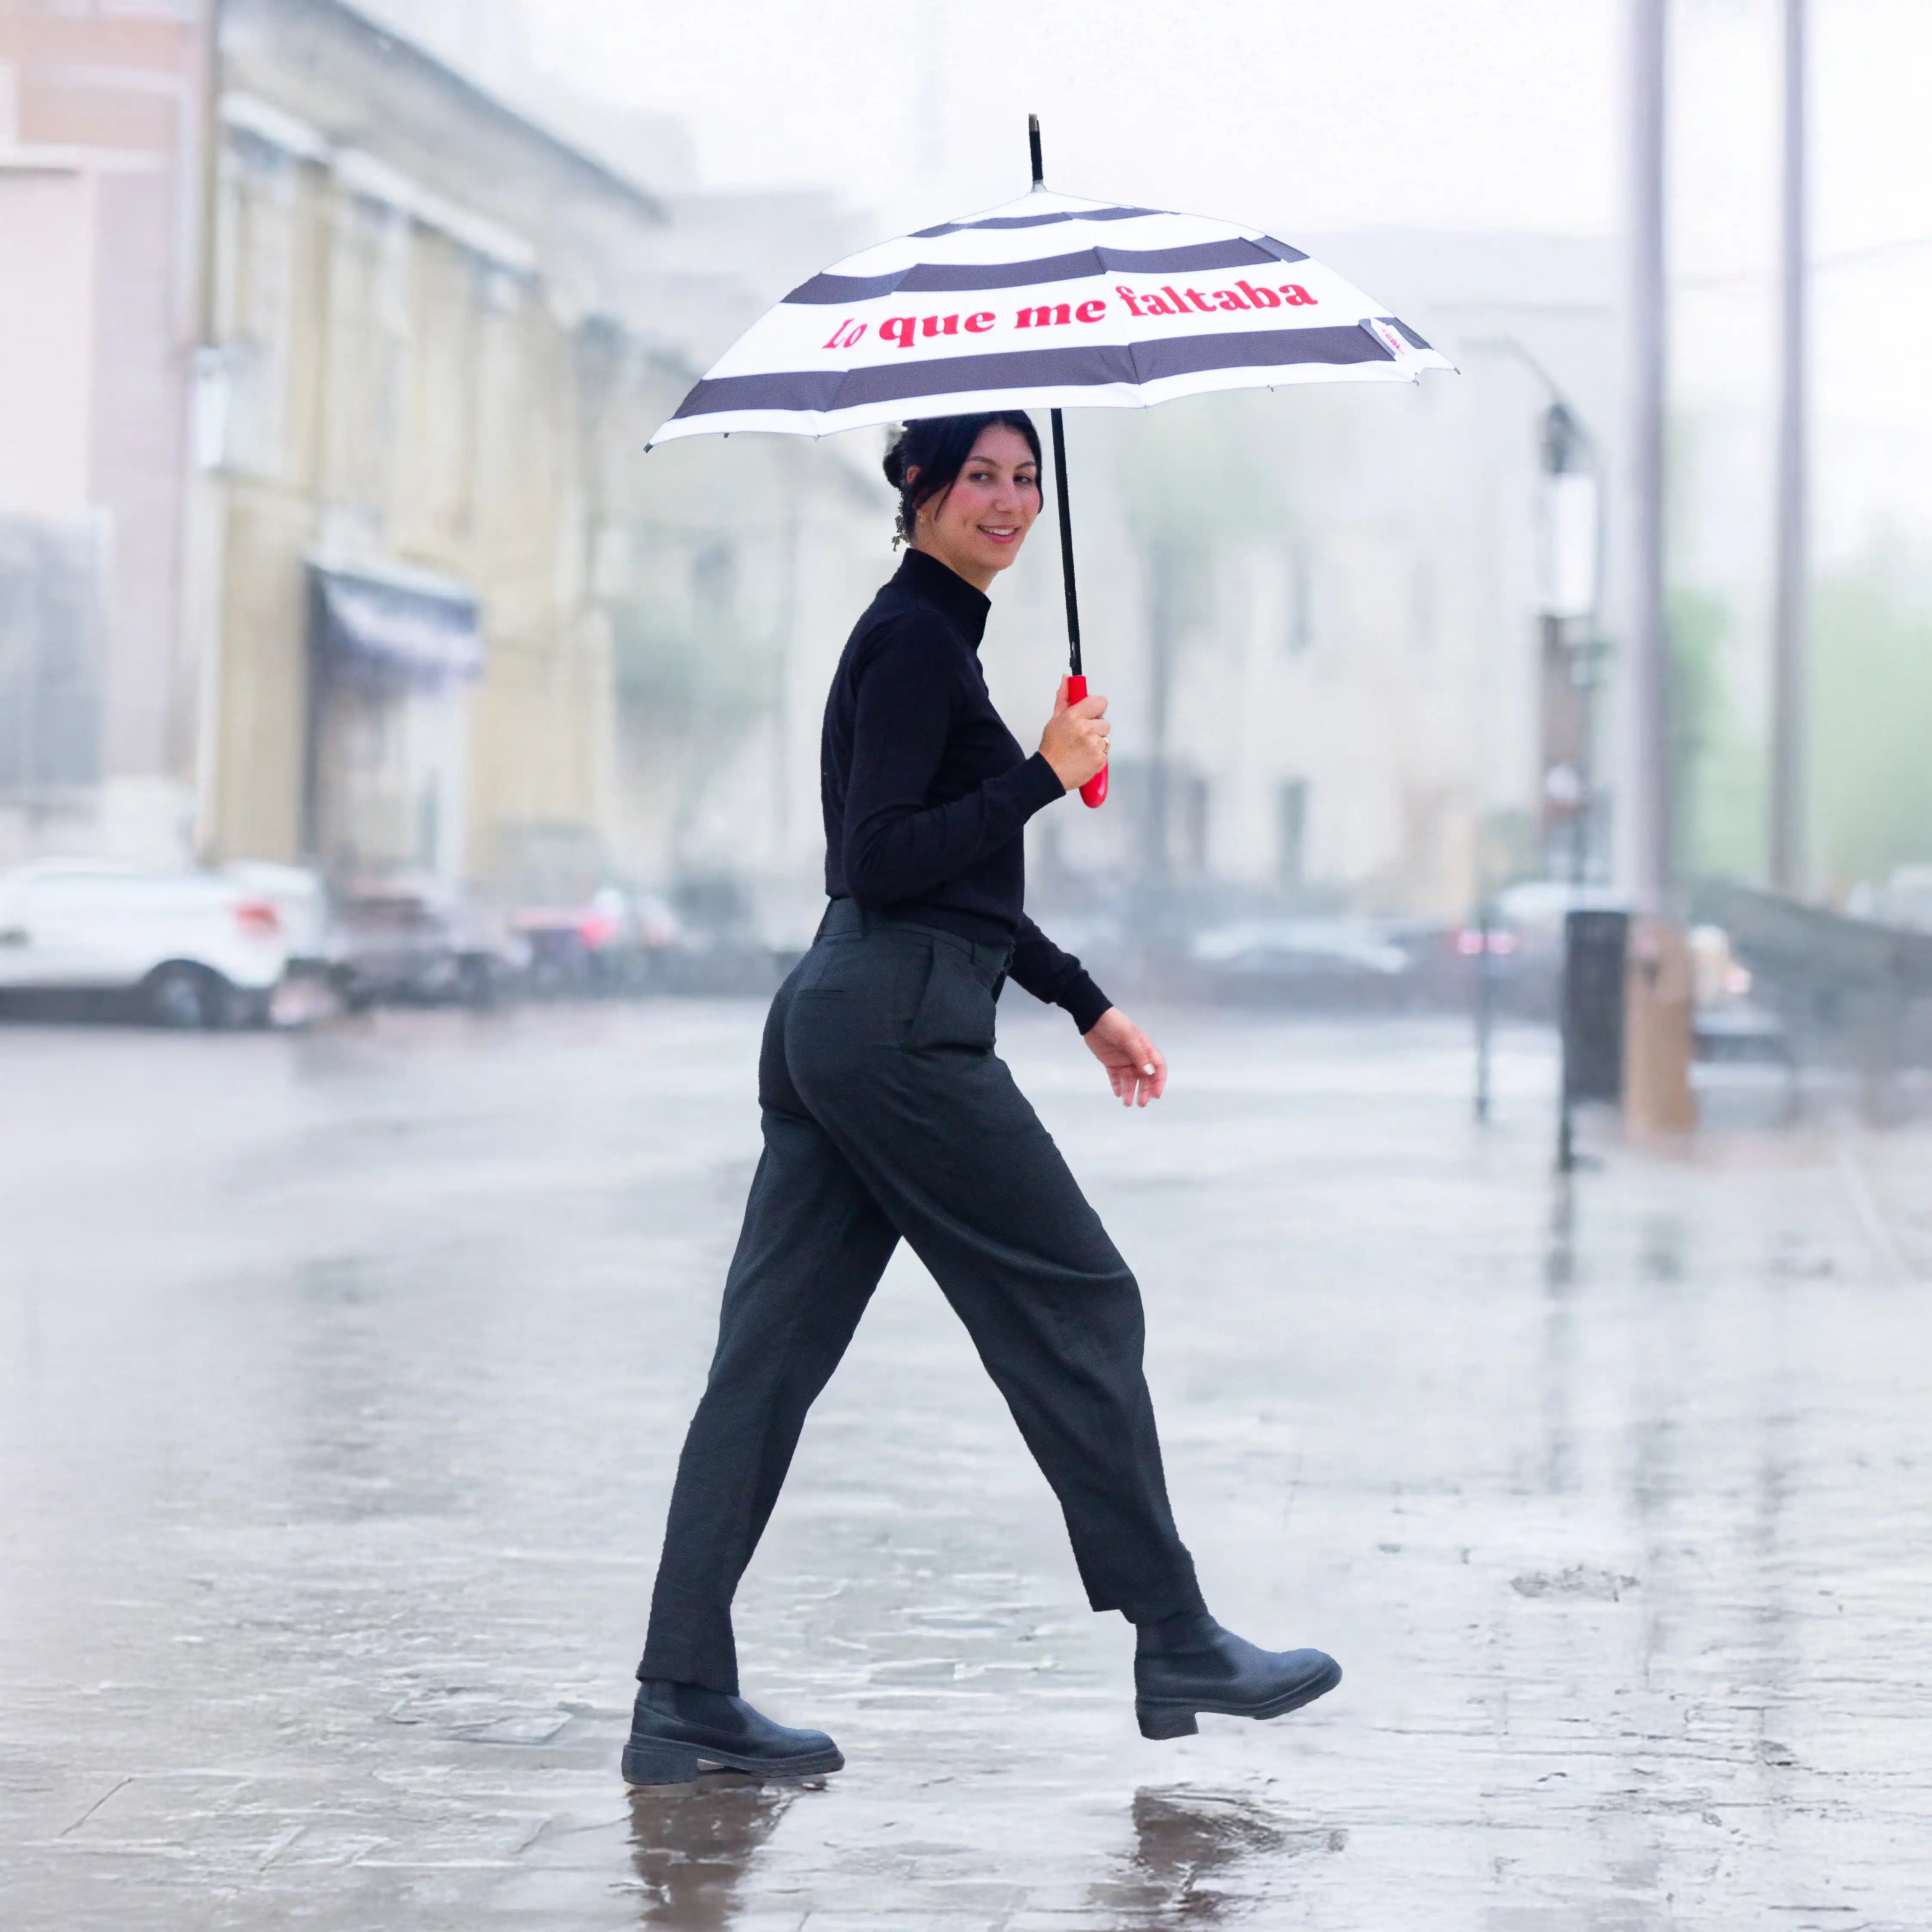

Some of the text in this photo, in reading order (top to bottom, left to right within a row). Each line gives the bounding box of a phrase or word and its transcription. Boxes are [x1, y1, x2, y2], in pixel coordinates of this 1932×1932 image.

[821, 279, 1319, 349] Lo que me faltaba
